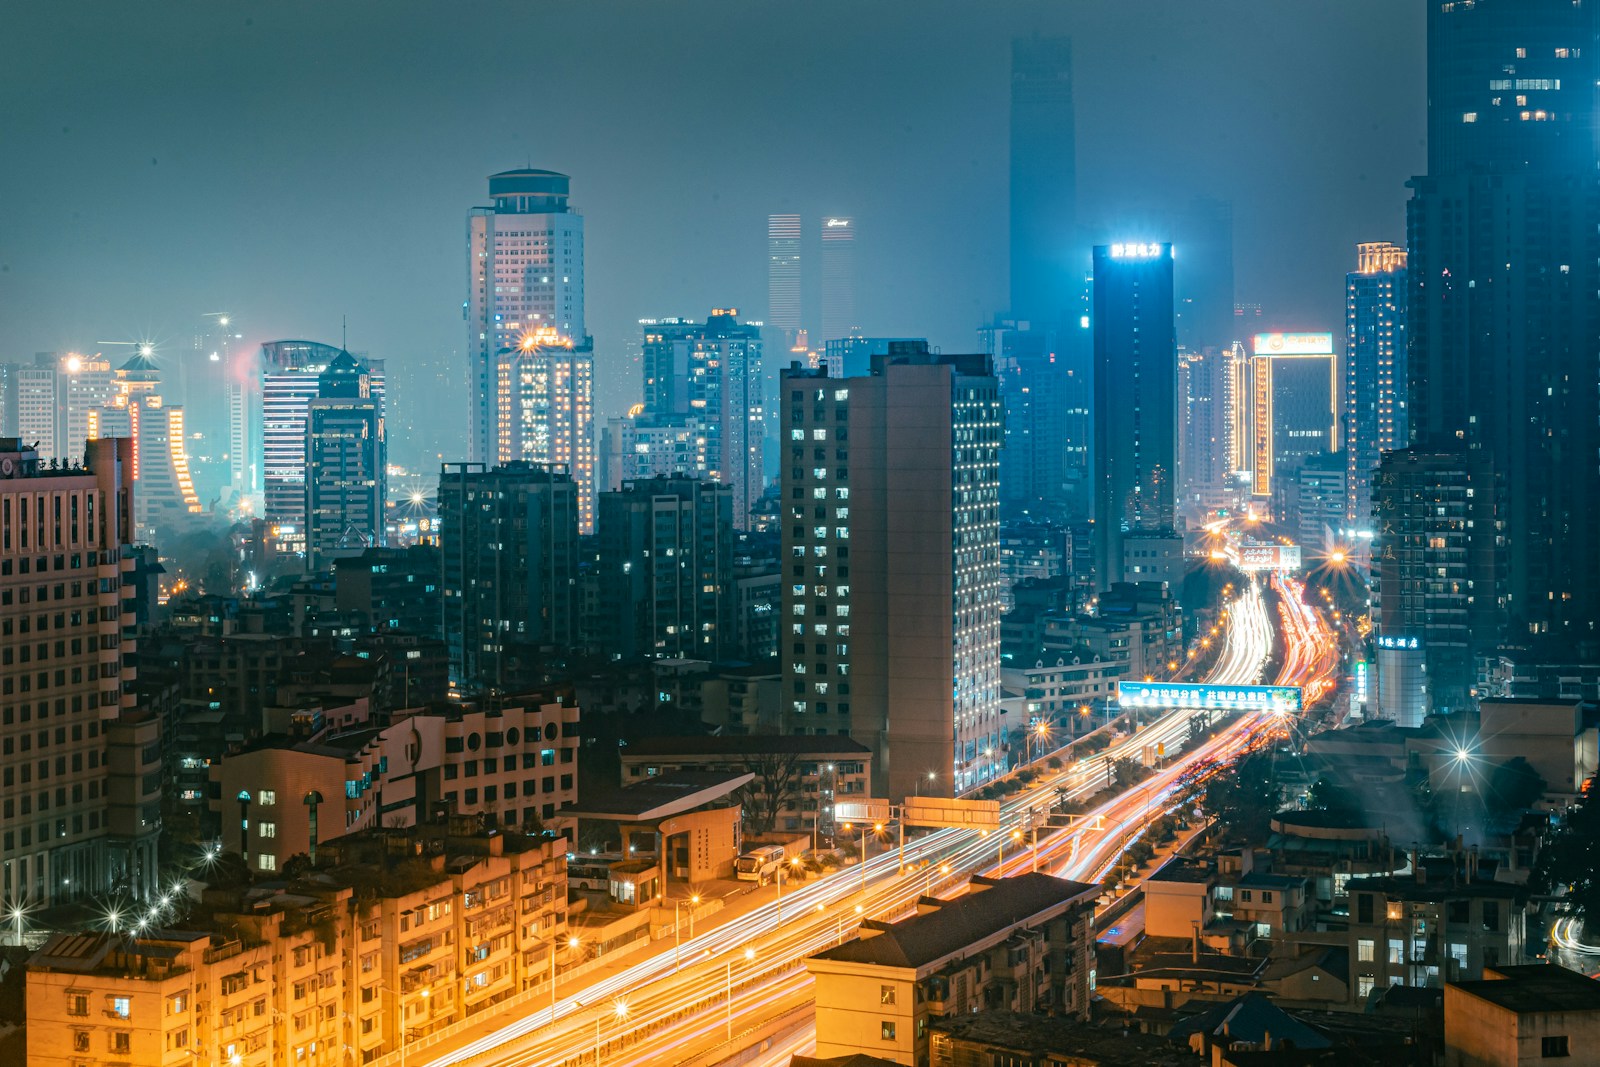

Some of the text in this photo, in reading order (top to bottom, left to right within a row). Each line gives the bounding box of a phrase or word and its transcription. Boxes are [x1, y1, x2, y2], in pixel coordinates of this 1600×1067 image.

[1381, 472, 1399, 560] 黔龙大厦
[1206, 690, 1267, 702] 共建绿色贵阳
